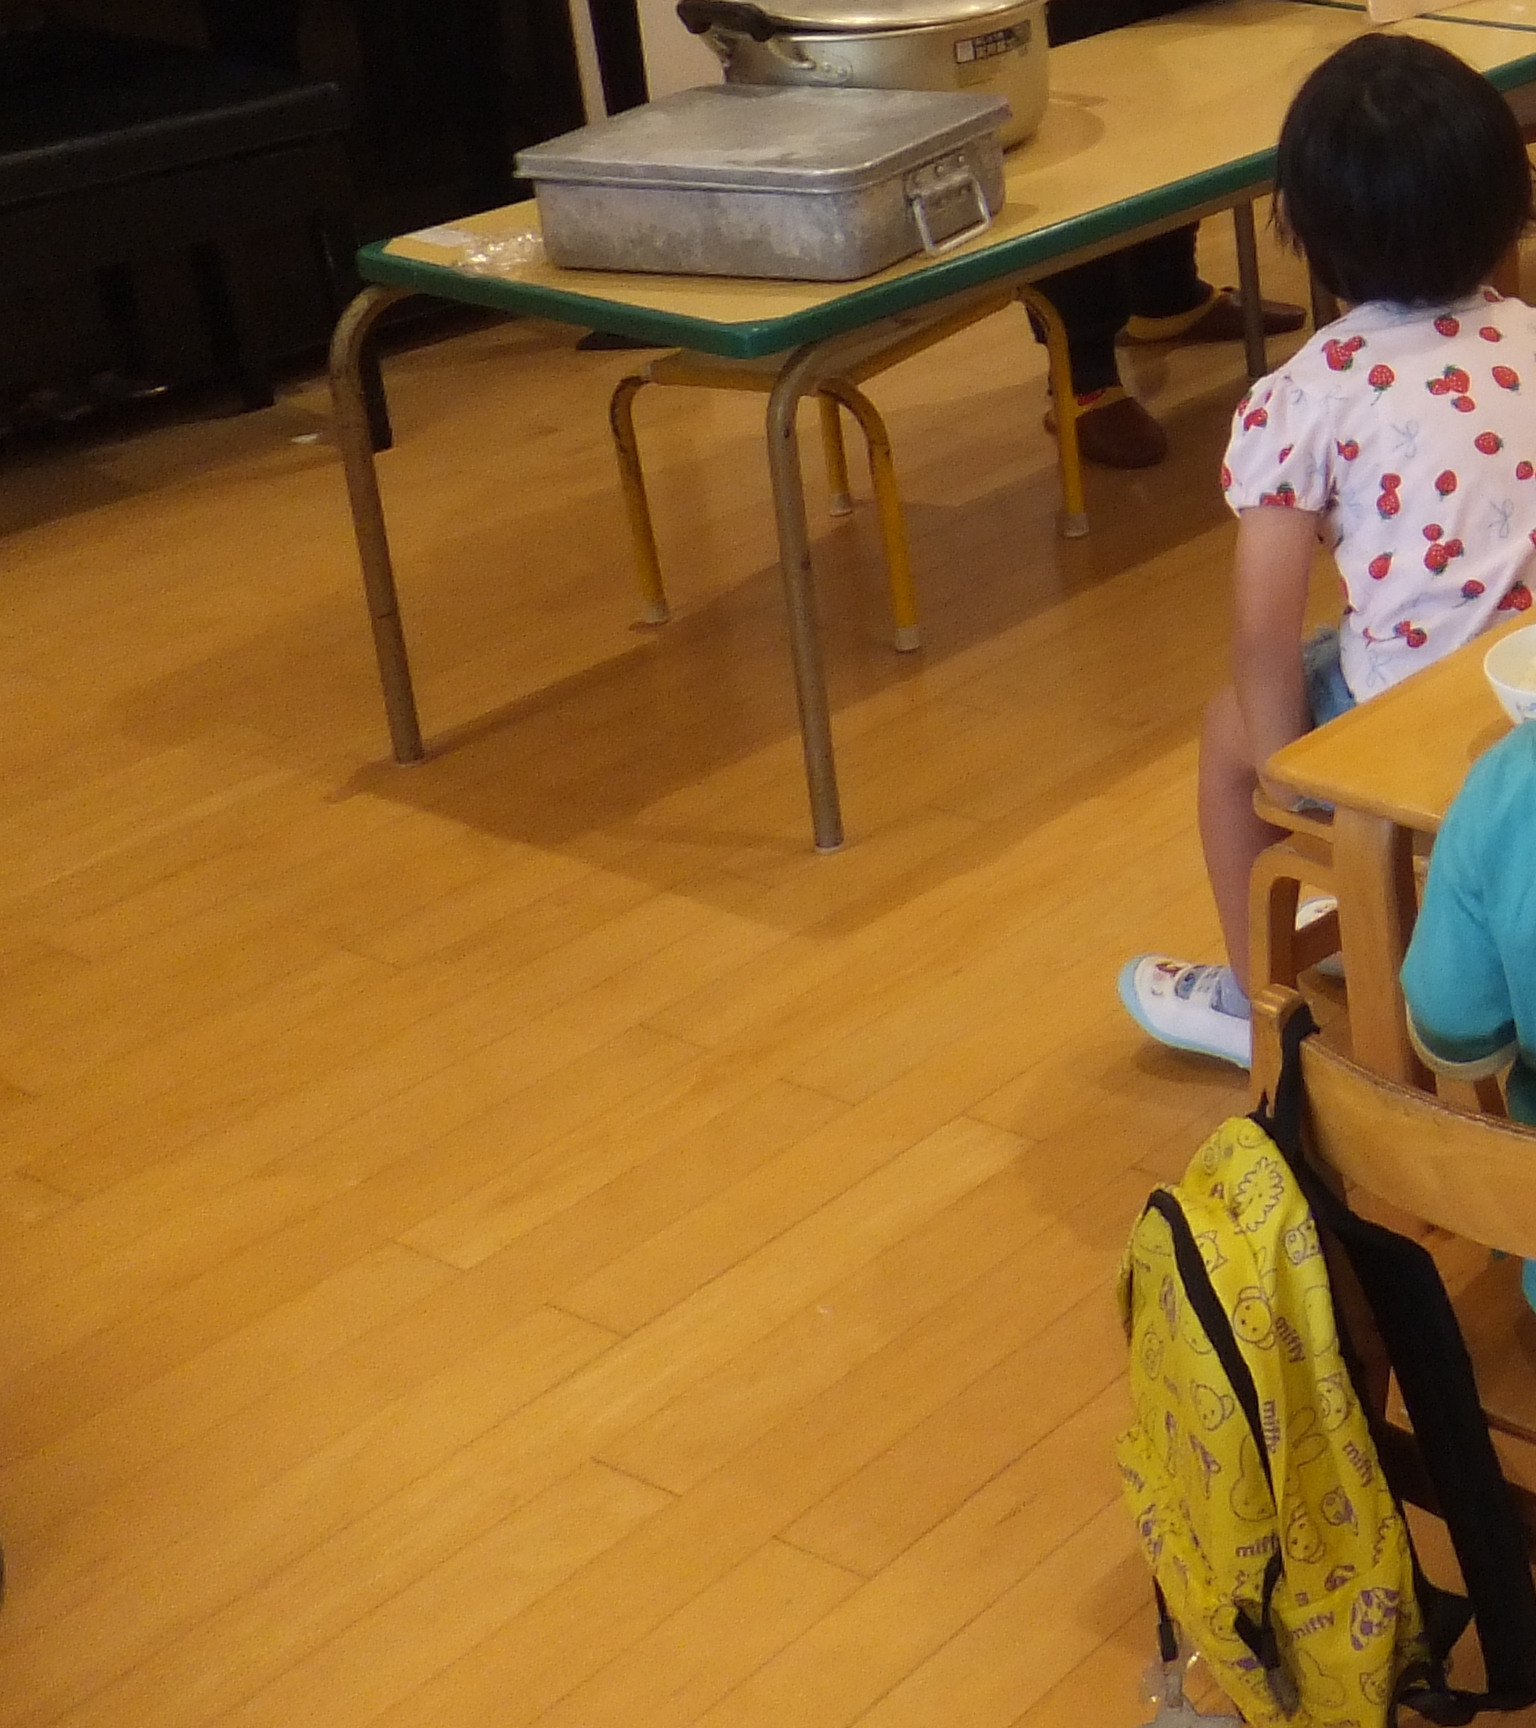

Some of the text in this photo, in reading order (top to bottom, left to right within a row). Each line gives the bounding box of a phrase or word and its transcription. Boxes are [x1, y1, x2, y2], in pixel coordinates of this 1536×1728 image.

[1275, 1316, 1306, 1364] miffy
[1342, 1440, 1375, 1488] miffy
[1293, 1610, 1335, 1640] miffy
